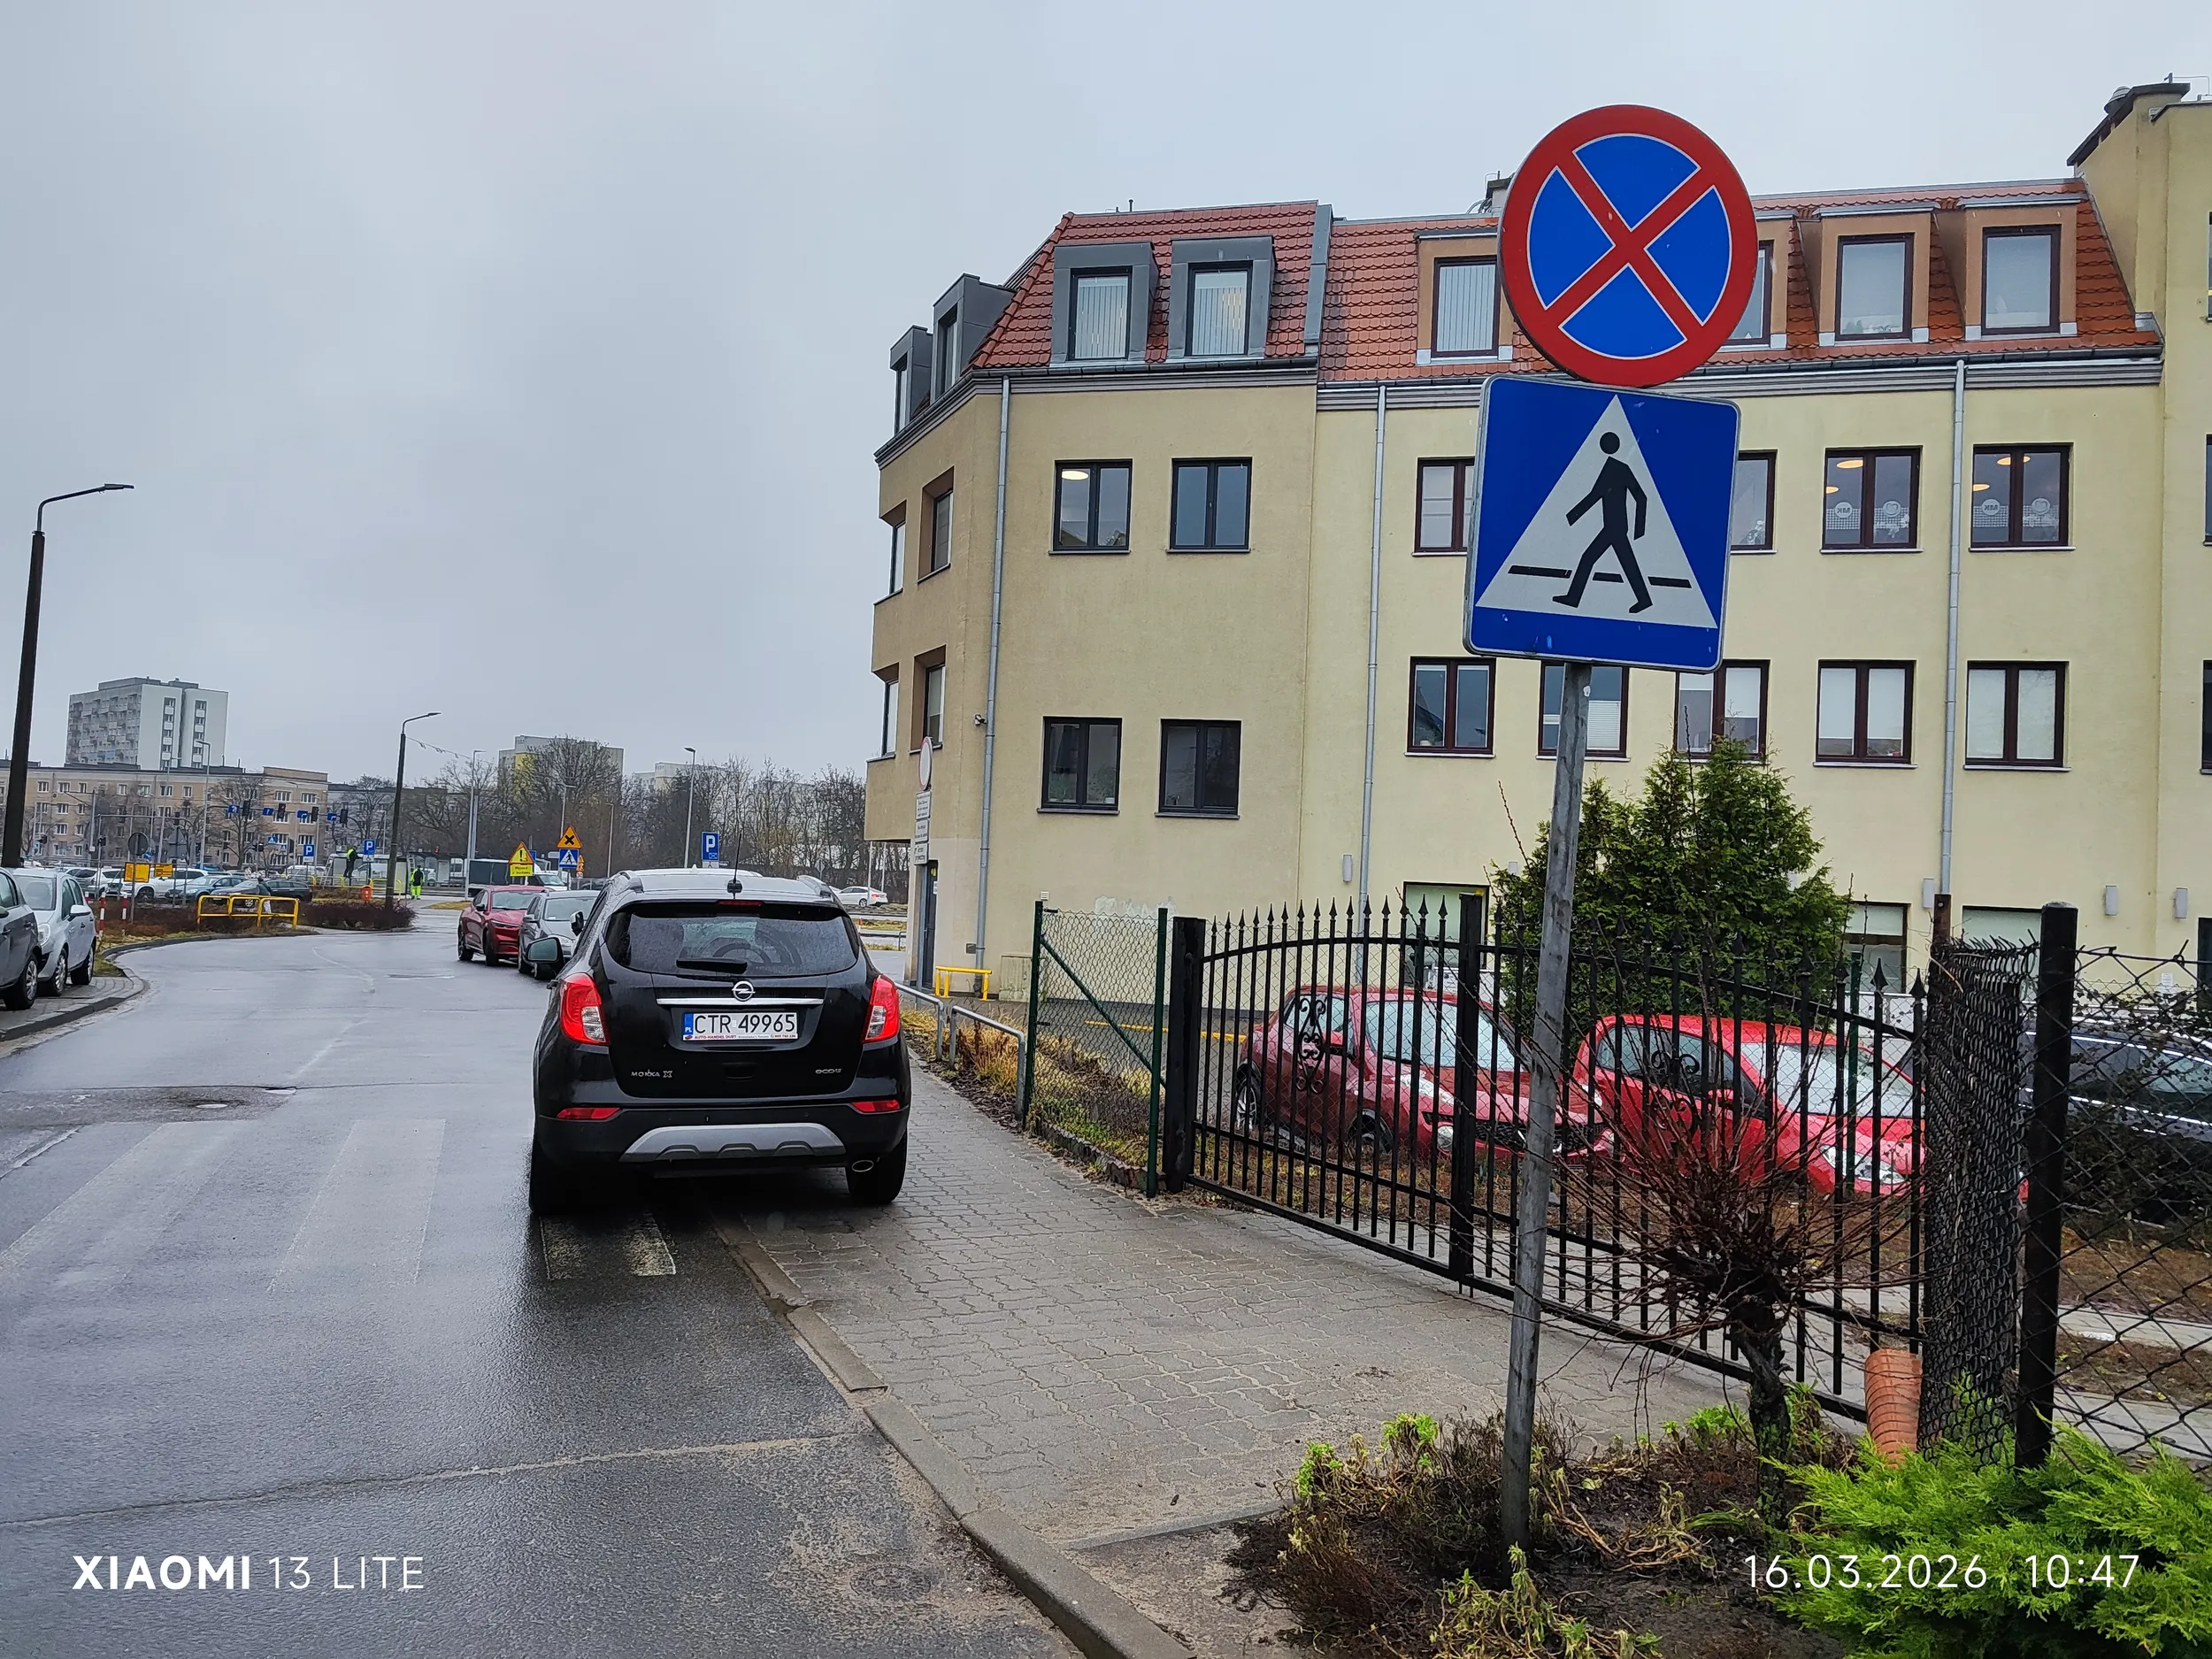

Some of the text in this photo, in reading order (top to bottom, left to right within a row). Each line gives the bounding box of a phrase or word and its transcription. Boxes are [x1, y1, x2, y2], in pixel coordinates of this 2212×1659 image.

[365, 841, 373, 850] P
[706, 834, 715, 852] P
[305, 845, 312, 856] P
[695, 1014, 795, 1033] CTR 49965
